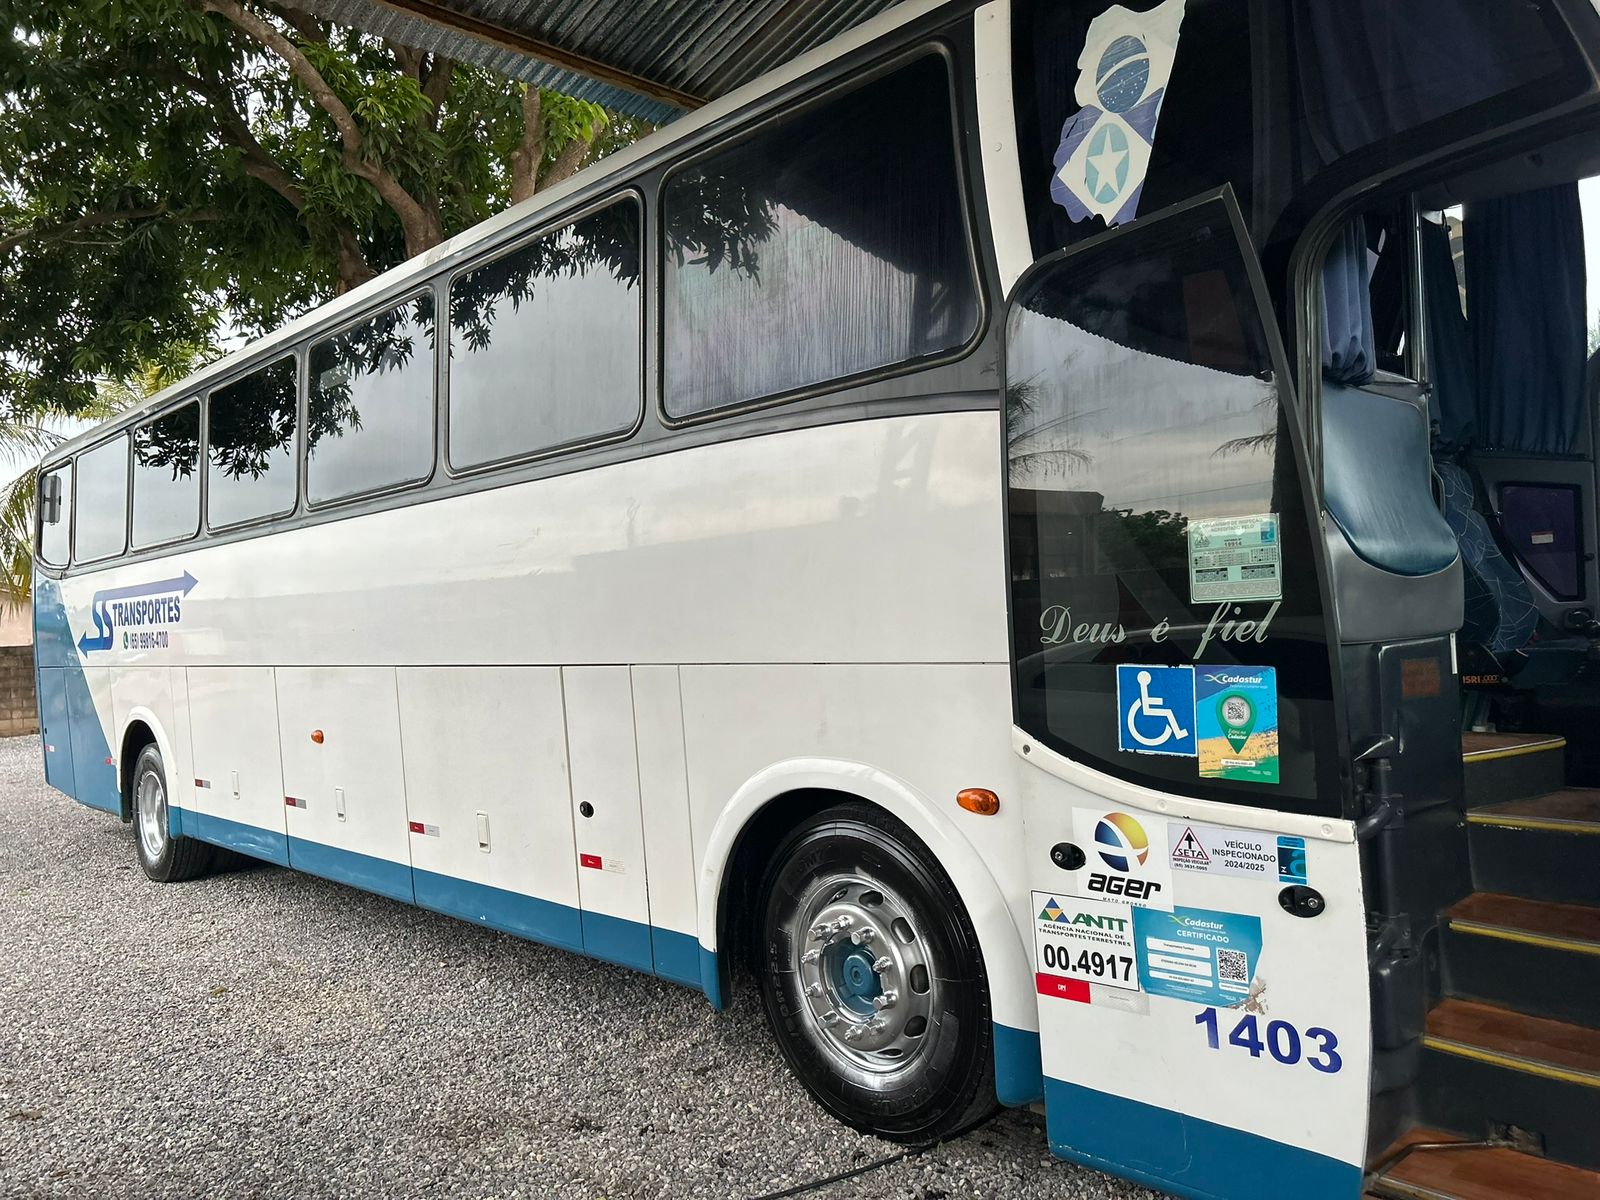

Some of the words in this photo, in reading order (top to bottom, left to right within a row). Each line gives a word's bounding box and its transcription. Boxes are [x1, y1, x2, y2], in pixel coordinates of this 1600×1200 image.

[112, 595, 181, 627] TRANSPORTES
[1039, 605, 1127, 644] Deus
[1150, 616, 1170, 644] é
[1193, 601, 1282, 660] fiel
[1222, 675, 1263, 684] Cadastur
[1177, 848, 1205, 858] SETA
[1224, 840, 1262, 852] VEÍCULO
[1212, 848, 1276, 863] INSPECIONADO
[1224, 860, 1265, 872] 2024/2025
[1071, 912, 1129, 932] ANTT
[1184, 917, 1224, 930] Cadastur
[1038, 928, 1087, 940] TRANSPORTES
[1088, 936, 1131, 947] TERRESTRES
[1043, 922, 1074, 933] AGÊNCIA
[1075, 927, 1113, 939] NACIONAL
[1176, 929, 1230, 943] CERTIFICADO
[1043, 943, 1133, 981] 00.4917
[1194, 1006, 1344, 1076] 1403
